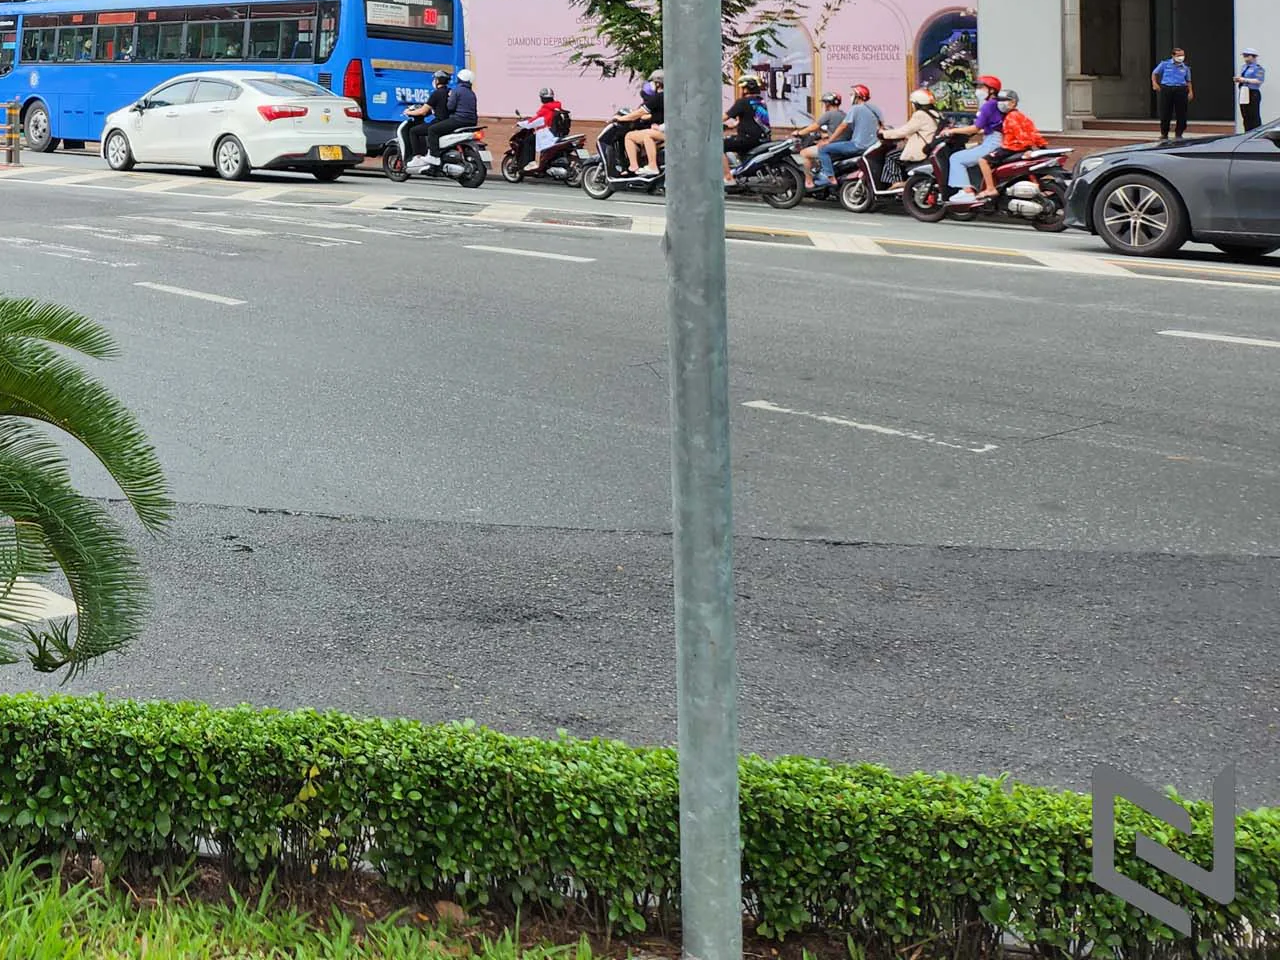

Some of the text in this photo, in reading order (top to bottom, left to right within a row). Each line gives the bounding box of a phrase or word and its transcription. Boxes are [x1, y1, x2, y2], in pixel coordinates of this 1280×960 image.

[507, 37, 542, 46] DIAMOND
[827, 44, 900, 52] STORE RENOVATION
[826, 53, 901, 61] OPENING SCHEDULE
